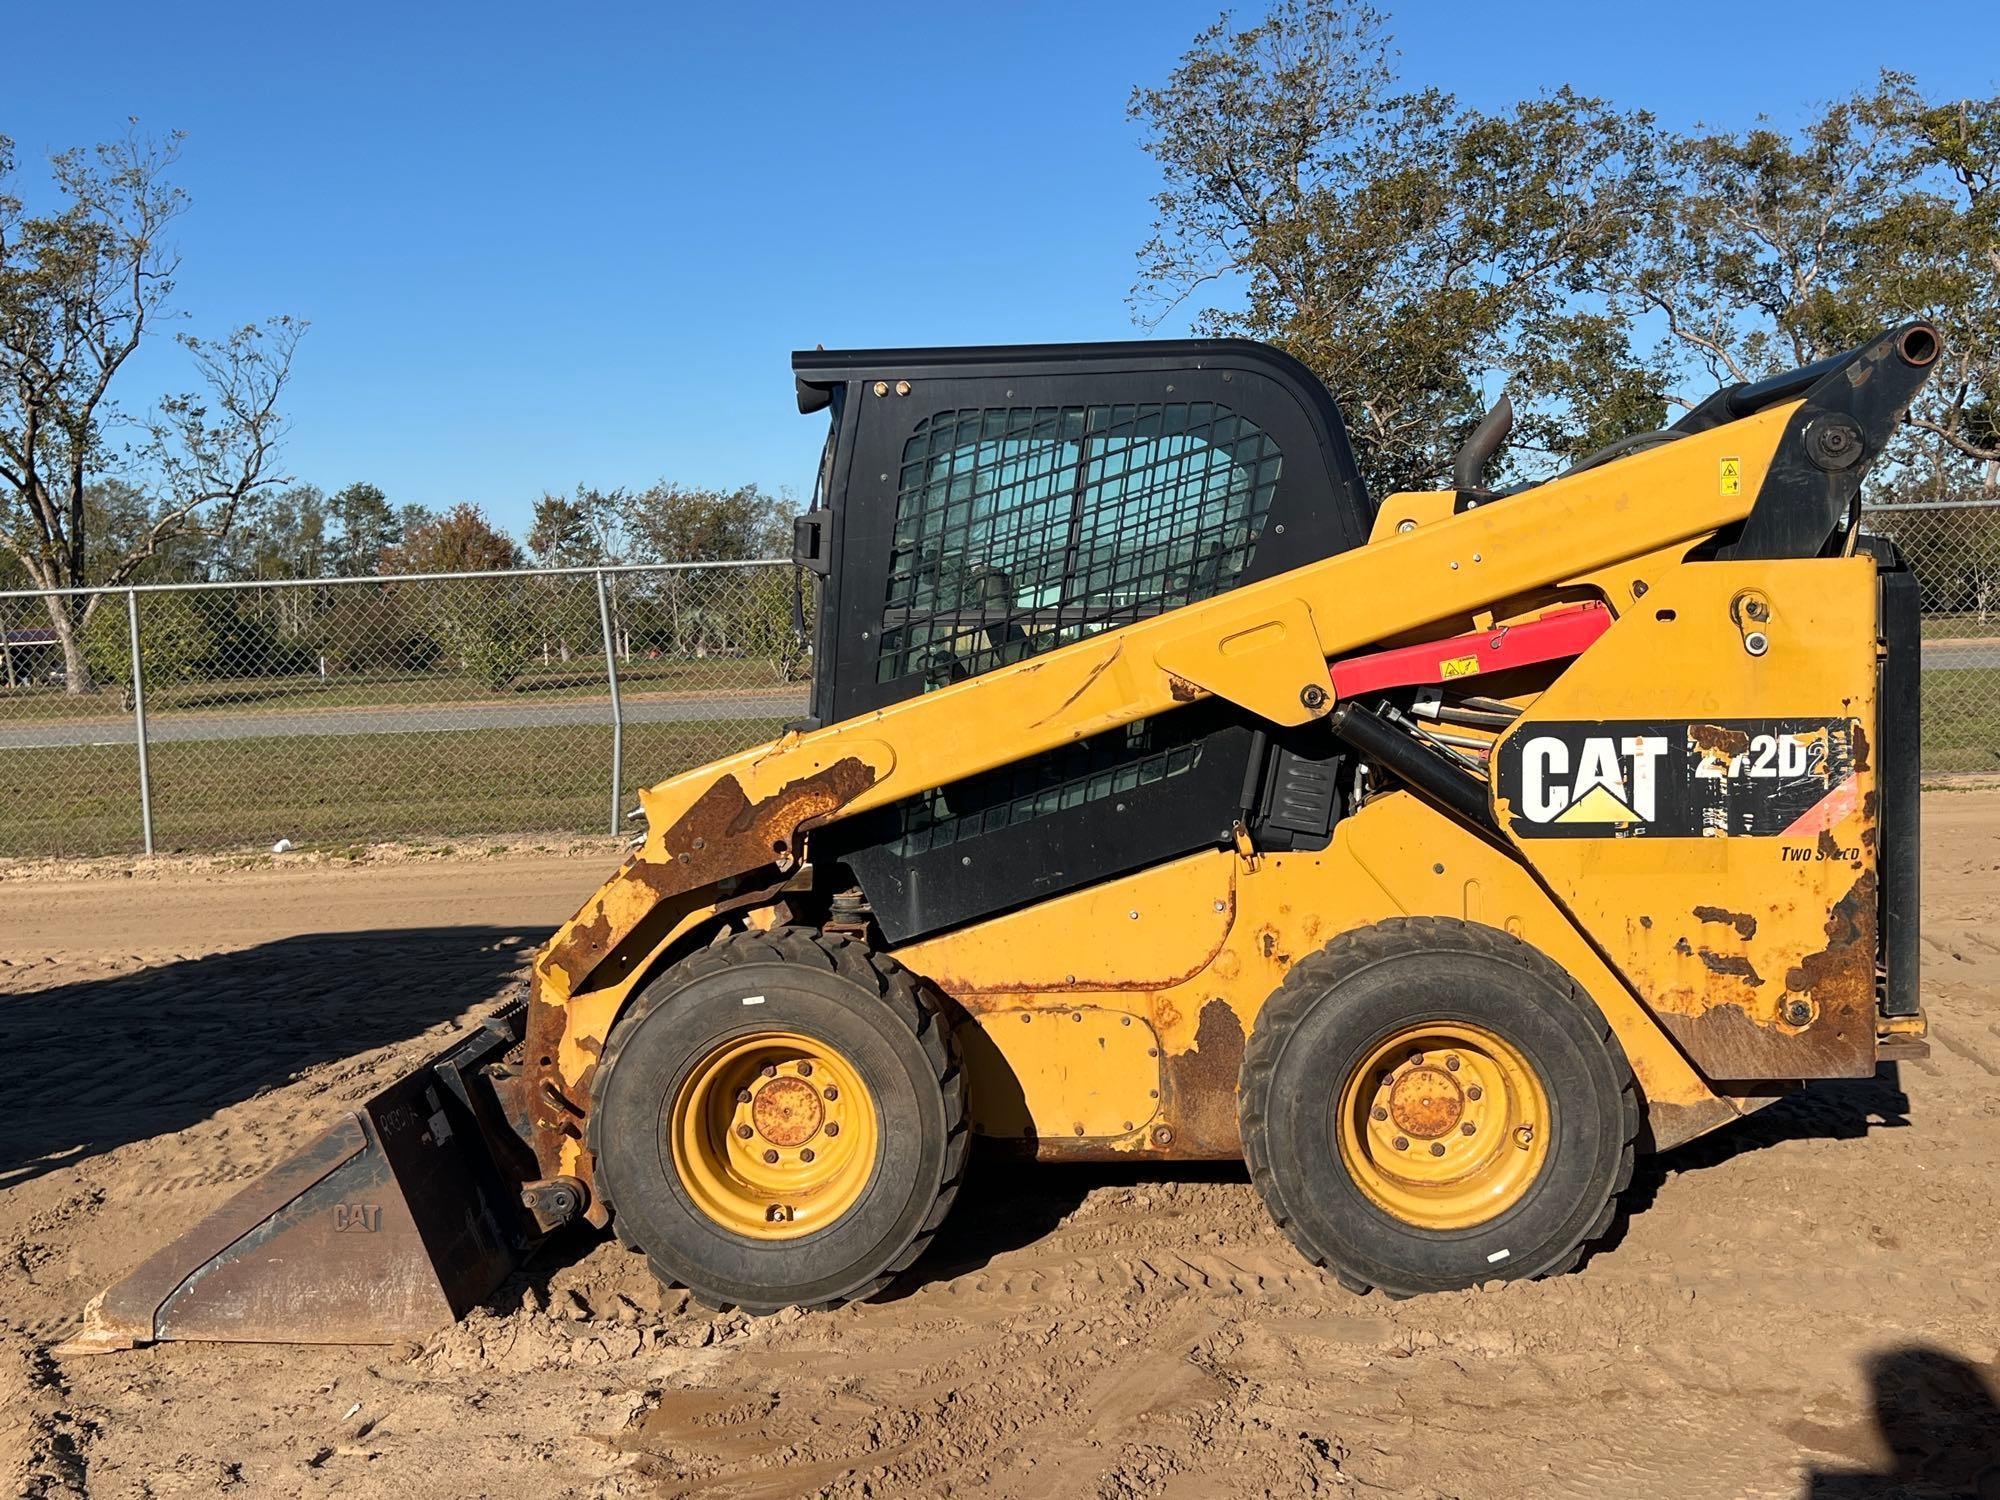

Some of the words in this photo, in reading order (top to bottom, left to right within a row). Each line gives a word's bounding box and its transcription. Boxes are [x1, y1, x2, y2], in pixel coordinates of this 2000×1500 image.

[1522, 736, 1668, 823] CAT
[1781, 846, 1812, 861] TWO
[1815, 847, 1860, 861] SED
[332, 1204, 381, 1233] CAT
